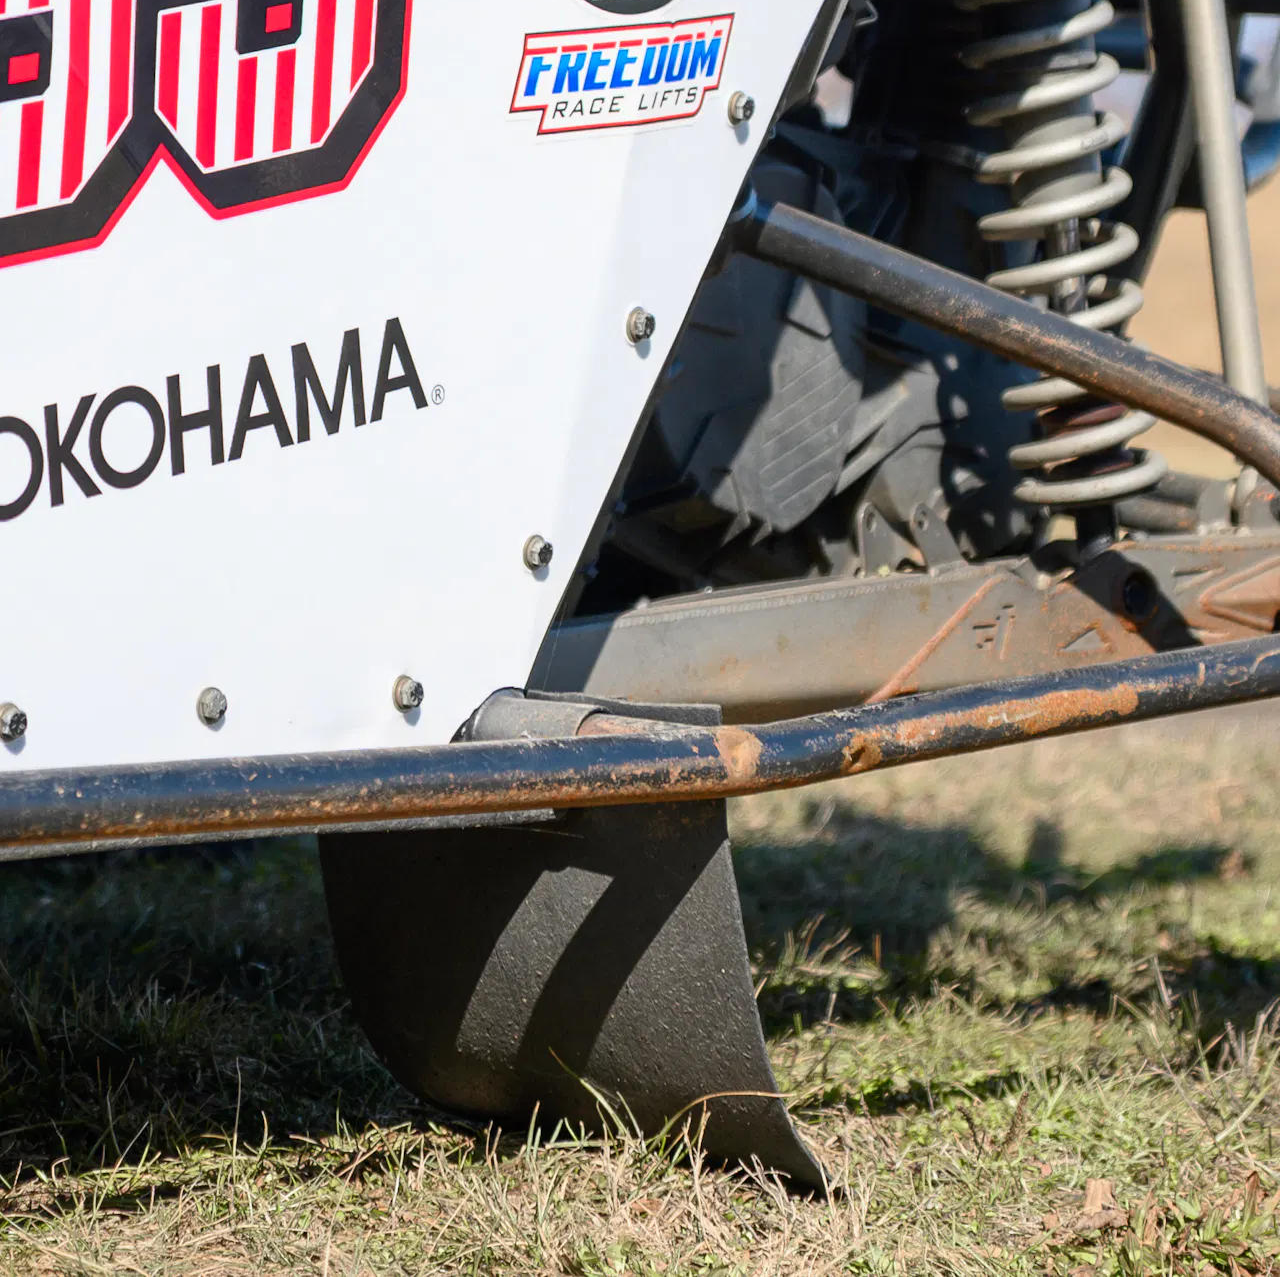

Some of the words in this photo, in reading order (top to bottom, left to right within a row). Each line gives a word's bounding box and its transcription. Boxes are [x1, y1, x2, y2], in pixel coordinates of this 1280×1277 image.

[523, 29, 724, 97] FREEDOM
[551, 95, 625, 120] RACE
[637, 86, 699, 111] LIFTS
